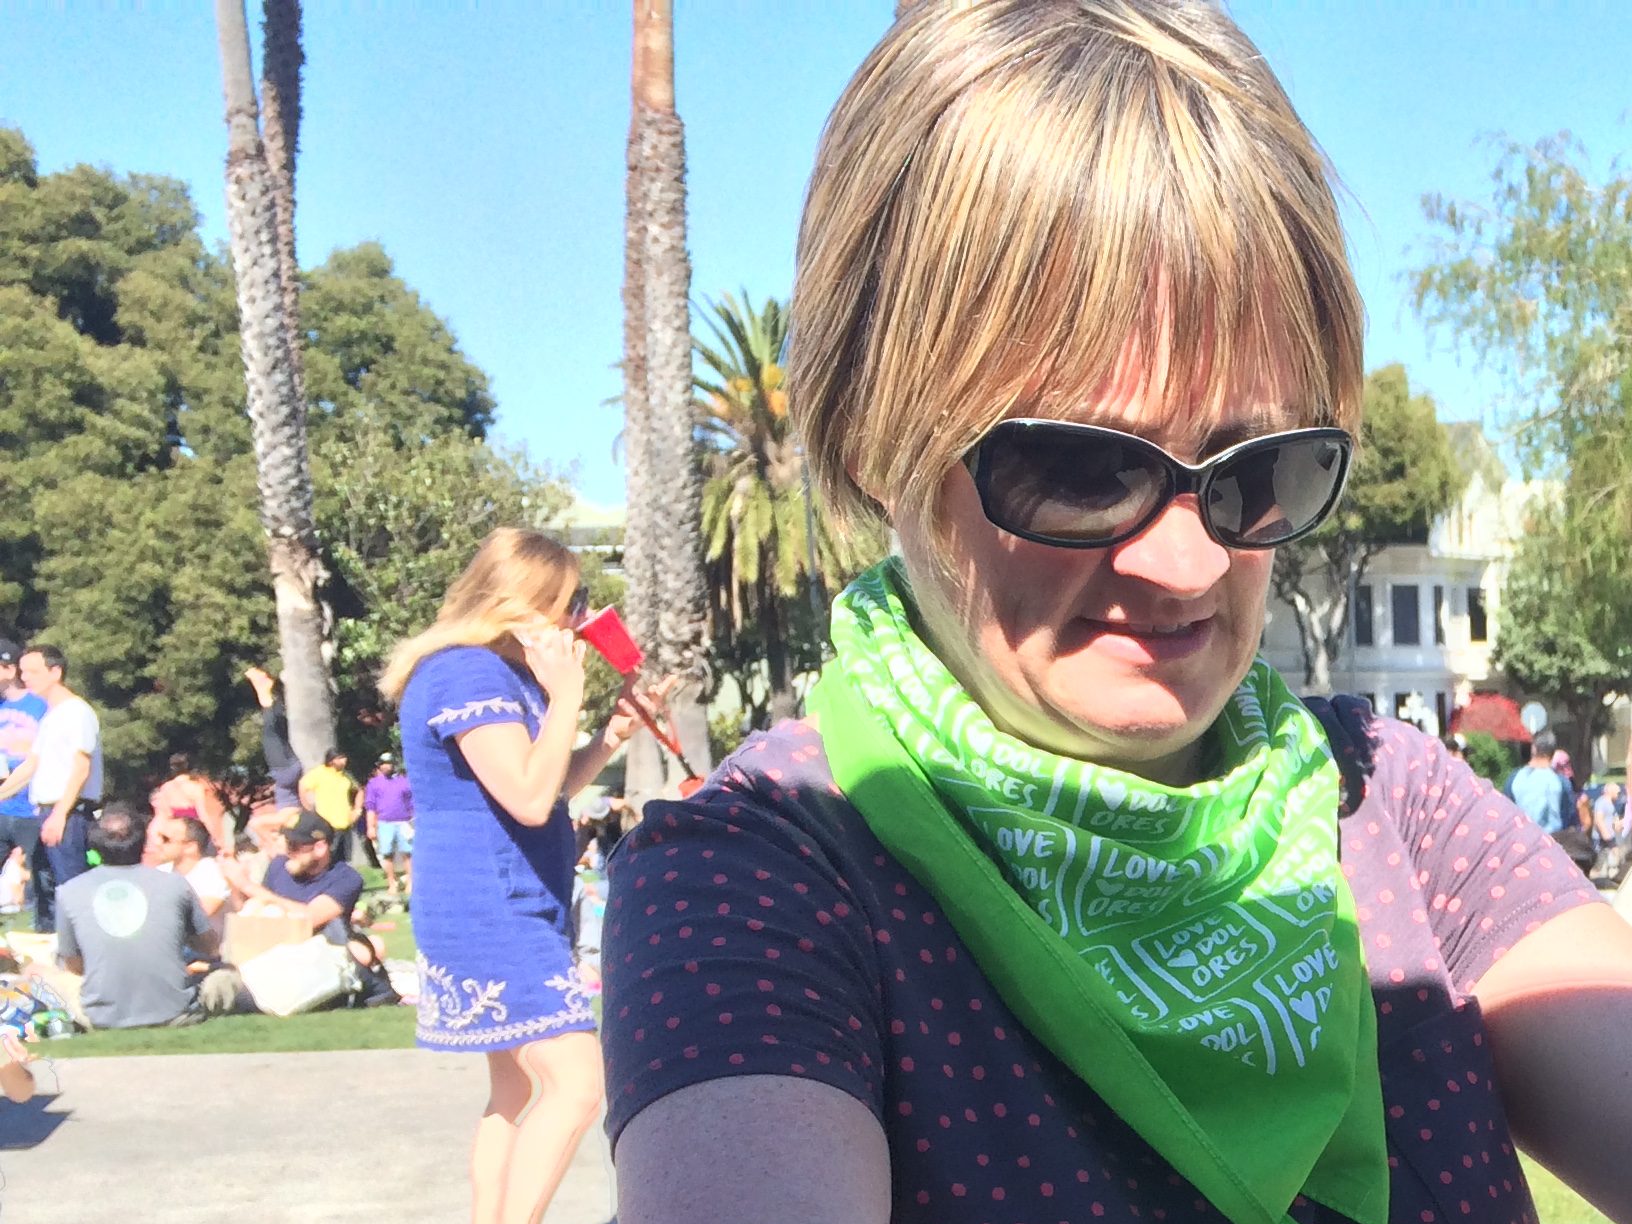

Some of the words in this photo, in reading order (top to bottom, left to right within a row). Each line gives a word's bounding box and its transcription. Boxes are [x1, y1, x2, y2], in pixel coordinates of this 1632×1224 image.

[993, 743, 1051, 778] DOL
[970, 758, 1038, 809] ORES
[1128, 788, 1183, 813] DOL
[1089, 811, 1170, 835] ORES
[985, 824, 1057, 858] OVE
[1195, 924, 1247, 956] DOL
[1192, 937, 1258, 987] ORES
[1274, 942, 1339, 996] LOVE
[1177, 1005, 1235, 1033] OVE
